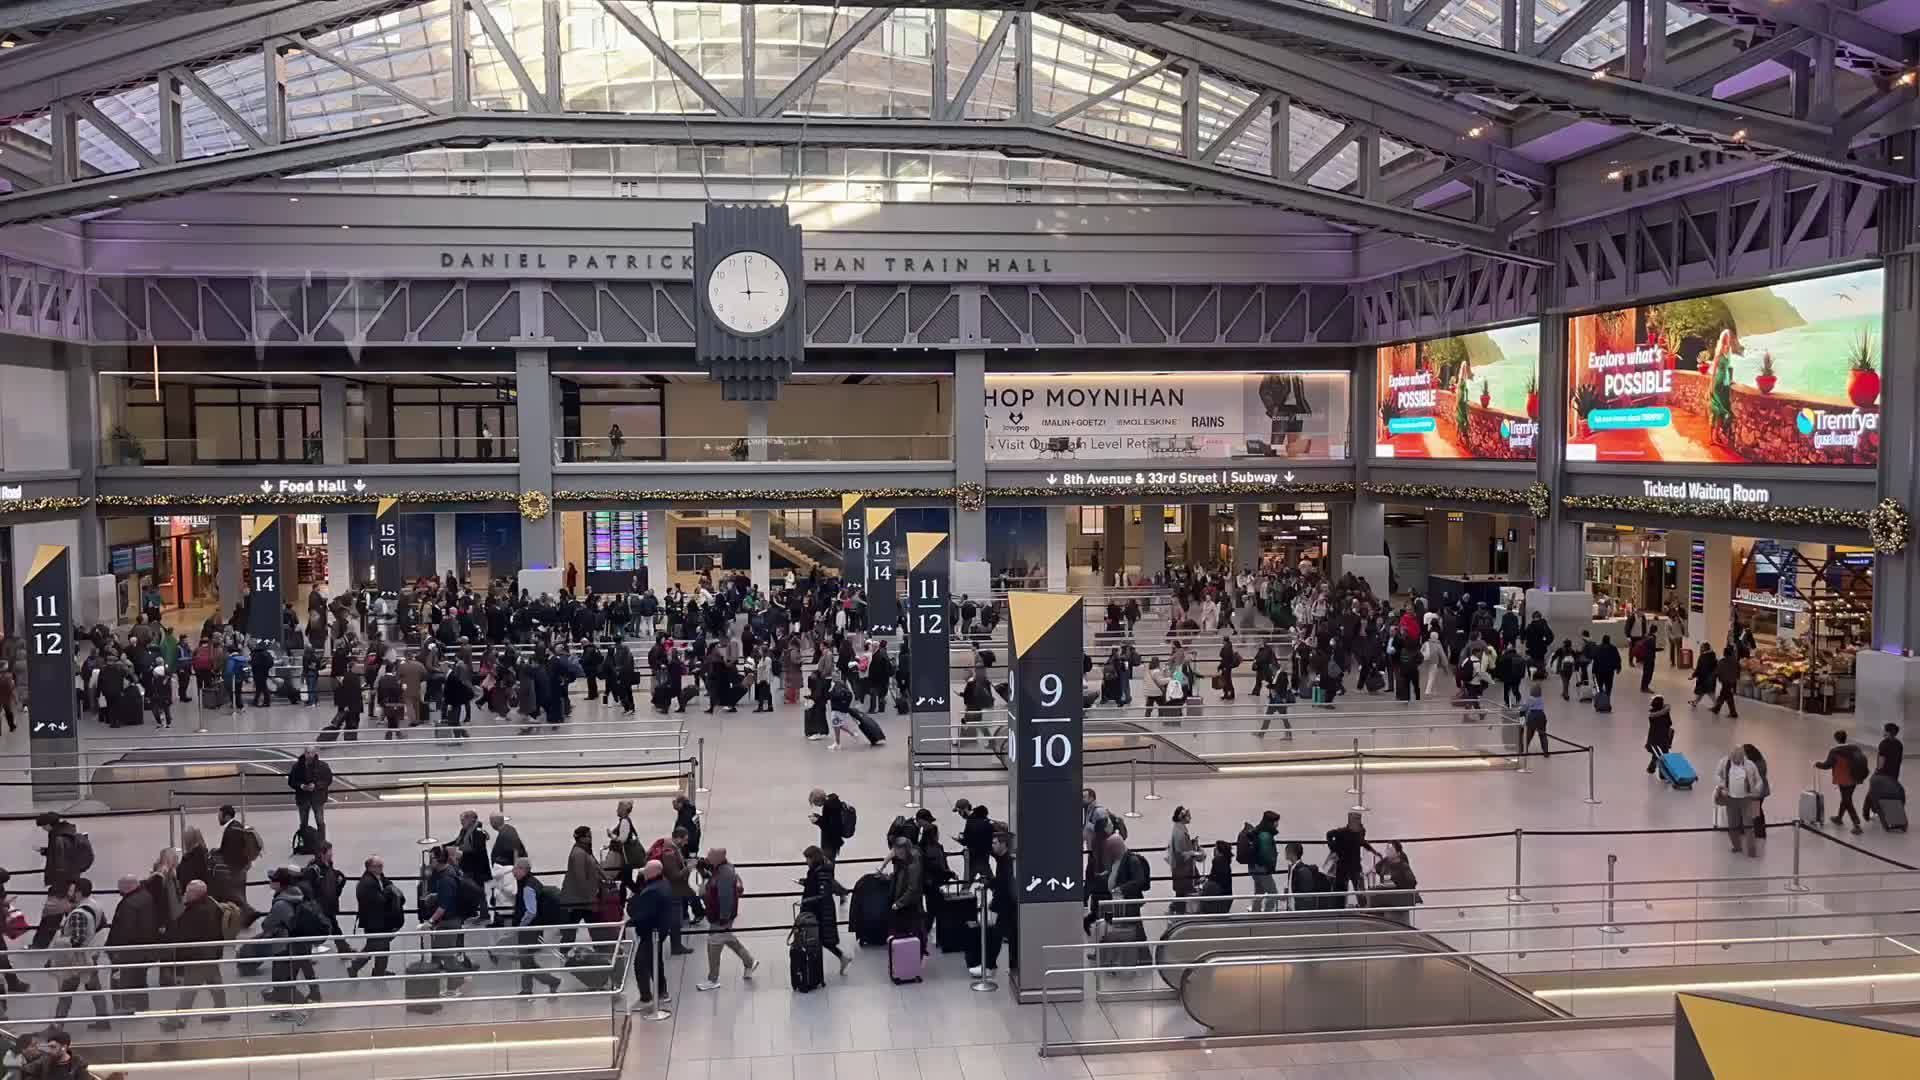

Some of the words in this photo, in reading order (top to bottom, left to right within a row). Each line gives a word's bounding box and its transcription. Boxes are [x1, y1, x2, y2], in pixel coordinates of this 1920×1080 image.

[440, 253, 547, 269] DANIEL
[567, 253, 693, 269] PATRICK
[813, 257, 865, 272] HAN
[884, 257, 969, 273] TRAIN
[987, 258, 1053, 273] HALL
[1589, 350, 1625, 373] Explore
[1626, 343, 1663, 365] what's
[1604, 369, 1673, 397] POSSIBLE
[984, 388, 1035, 407] HOP
[1046, 388, 1184, 407] MOYNIHAN
[1398, 390, 1436, 408] POSSIBLE
[1191, 416, 1225, 428] RAINS
[998, 438, 1025, 450] Visit
[1091, 437, 1122, 450] Level
[1063, 473, 1084, 485] 8th
[1087, 473, 1132, 484] Avenue
[1135, 474, 1145, 484] &
[1148, 472, 1176, 484] 33rd
[1179, 472, 1218, 484] Street
[1231, 471, 1278, 484] Subway
[279, 480, 314, 493] Food
[317, 480, 347, 492] Hall
[1643, 480, 1686, 499] Ticketed
[1688, 481, 1731, 504] Waiting
[1733, 483, 1769, 503] Room
[380, 523, 395, 536] 15
[848, 518, 861, 530] 15
[381, 543, 396, 556] 16
[848, 537, 861, 550] 16
[874, 540, 891, 555] 13
[255, 550, 274, 565] 13
[874, 565, 891, 580] 14
[255, 576, 275, 591] 14
[920, 579, 939, 599] 11
[34, 595, 58, 617] 11
[919, 613, 942, 634] 12
[33, 633, 63, 655] 12
[1039, 673, 1063, 707] 9
[1031, 733, 1072, 768] 10
